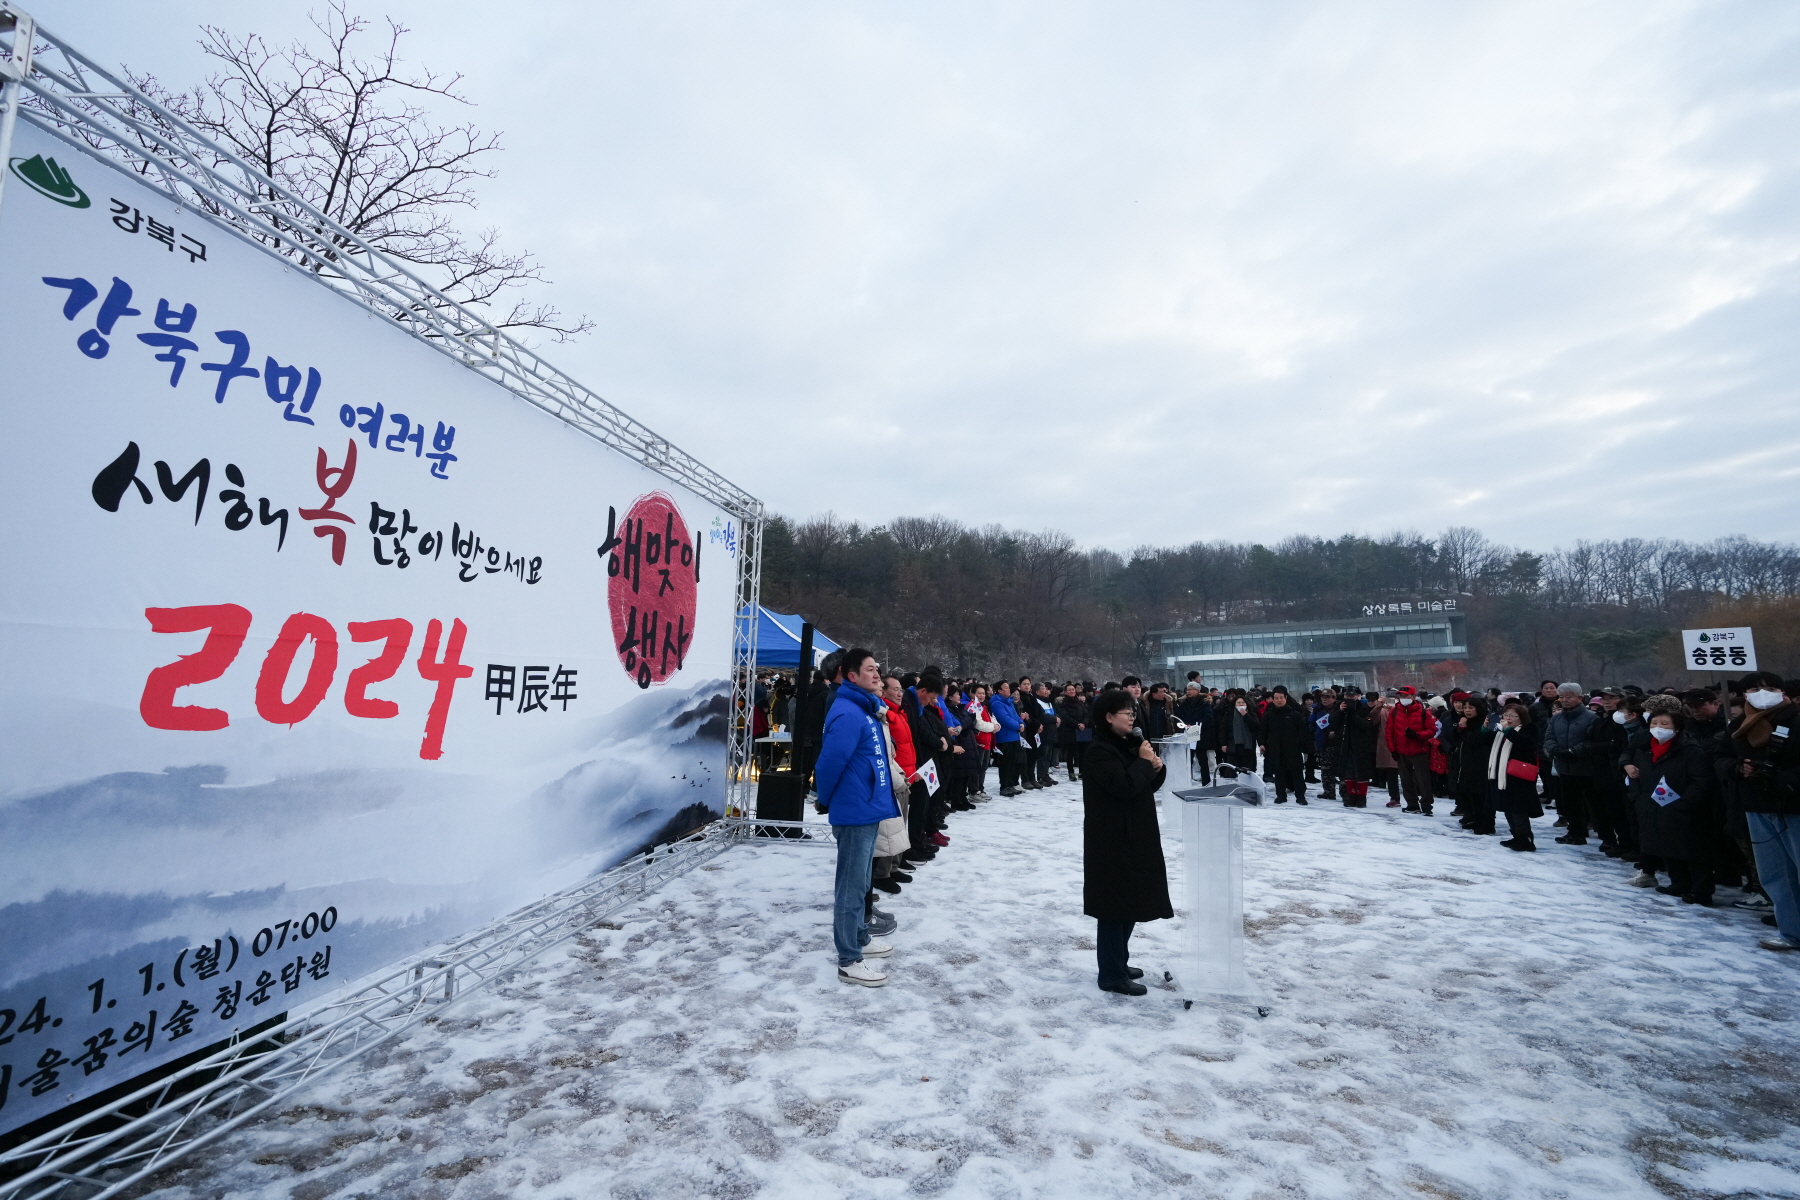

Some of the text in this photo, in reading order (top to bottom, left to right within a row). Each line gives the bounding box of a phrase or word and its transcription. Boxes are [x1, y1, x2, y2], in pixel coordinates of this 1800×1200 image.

[109, 197, 207, 264] 강북구
[41, 276, 459, 480] 강북구민 여러분
[91, 441, 289, 553] 새해
[298, 438, 359, 566] 복
[597, 506, 702, 597] 해맞이
[1417, 598, 1457, 612] 미술관
[1711, 632, 1736, 642] 강북구
[139, 603, 475, 761] 2024
[620, 606, 690, 690] 행사
[1691, 646, 1748, 666] 송중동
[485, 663, 579, 716] 甲辰年
[88, 978, 117, 1014] 1.
[252, 906, 338, 958] 07:00
[211, 945, 331, 1020] 청운답원
